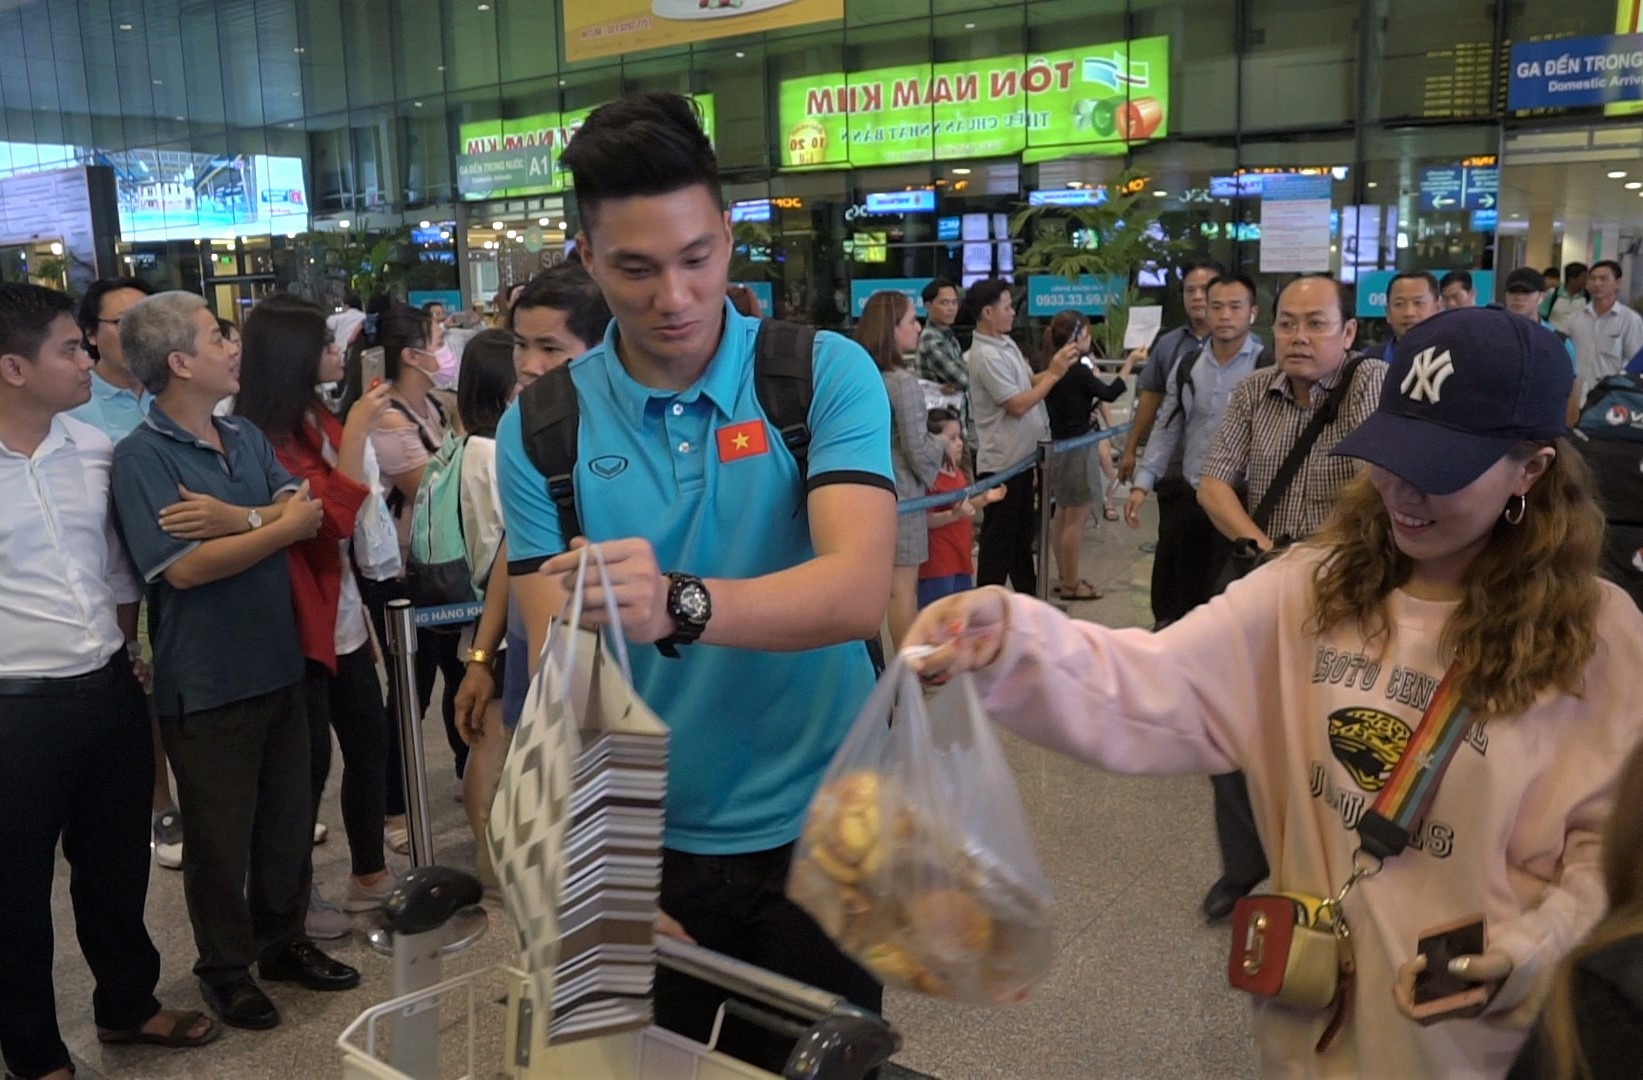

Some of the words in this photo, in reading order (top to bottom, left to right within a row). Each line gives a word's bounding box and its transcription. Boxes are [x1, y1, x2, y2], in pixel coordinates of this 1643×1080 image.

[1516, 61, 1541, 79] GA
[1544, 52, 1581, 77] ĐẾN
[1584, 51, 1643, 73] TRONG
[1548, 79, 1606, 93] Domestic
[529, 155, 548, 176] A1
[1401, 345, 1455, 405] NY
[431, 608, 465, 622] HÀNG
[1312, 647, 1382, 691] SOTO
